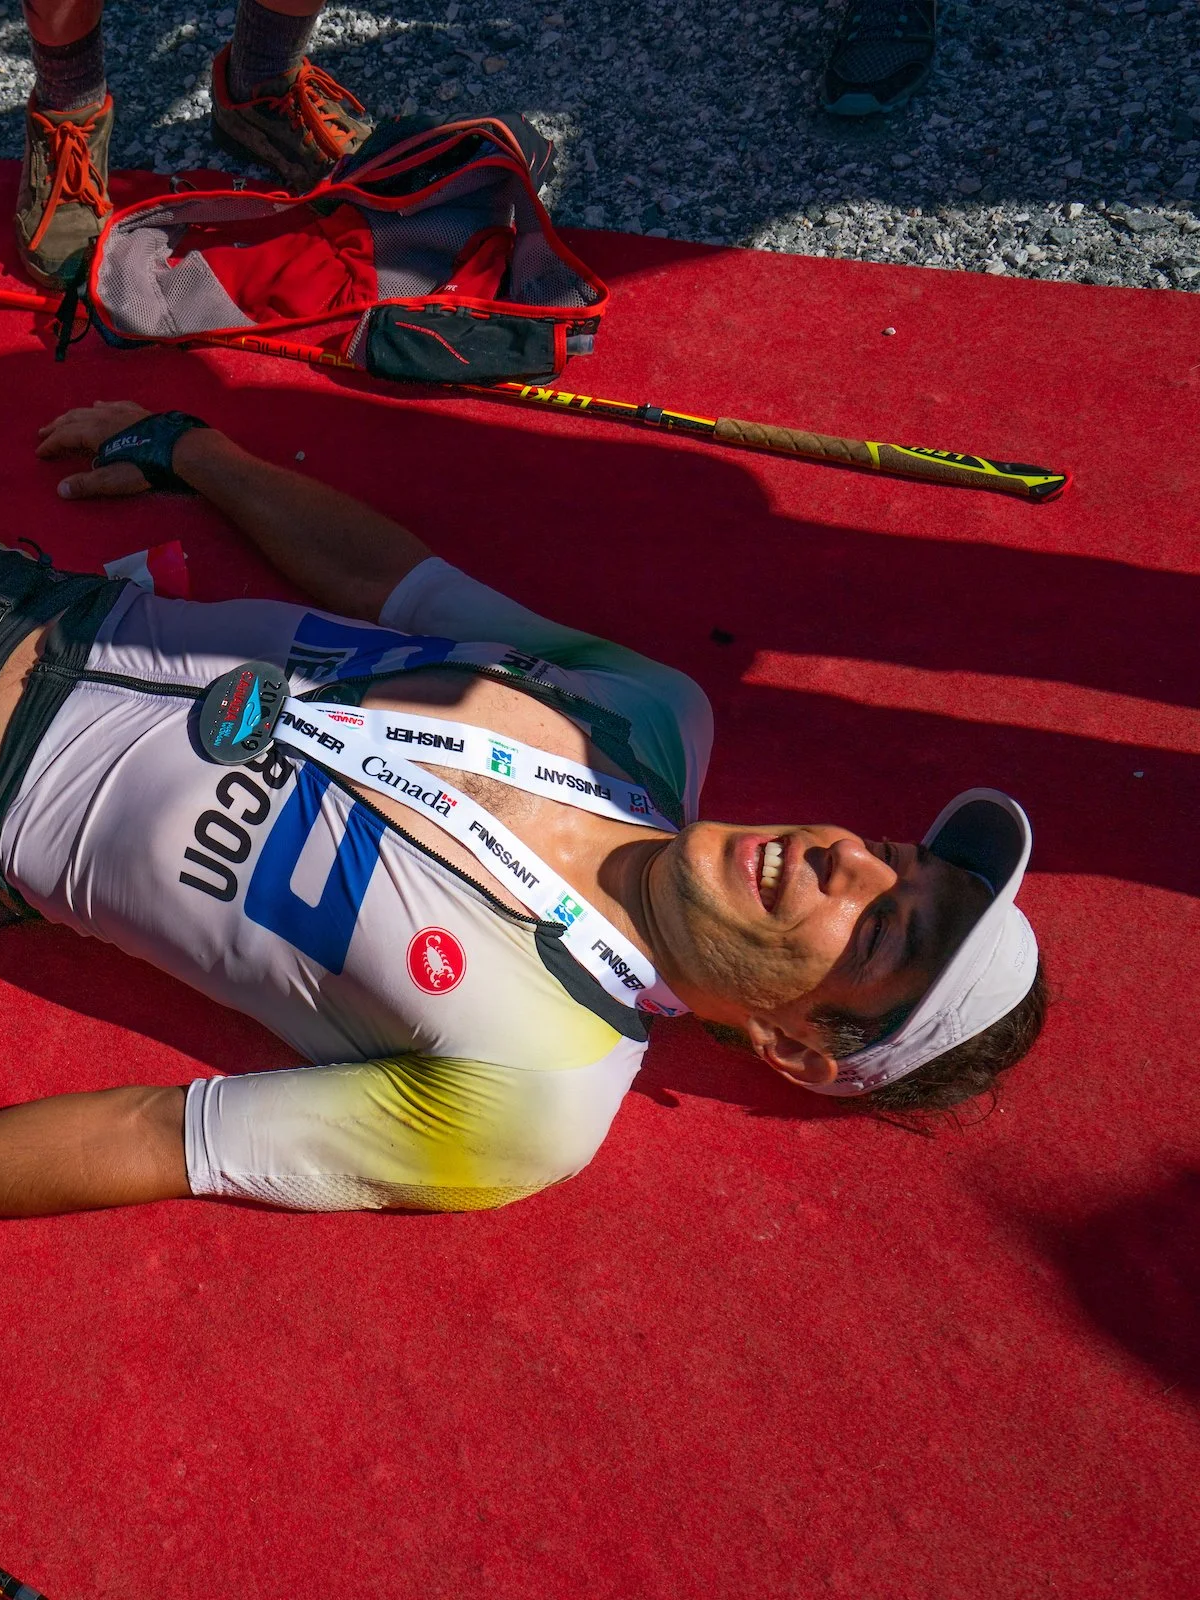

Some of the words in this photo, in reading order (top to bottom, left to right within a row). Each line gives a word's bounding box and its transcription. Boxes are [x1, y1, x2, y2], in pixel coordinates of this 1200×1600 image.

[519, 385, 593, 409] LEKI
[105, 435, 139, 452] LEKI
[223, 671, 254, 721] CANADA
[280, 711, 346, 755] FINISHER
[386, 726, 465, 753] FINISHER
[361, 756, 452, 818] Canada
[535, 765, 611, 801] FINISSANT
[468, 820, 540, 890] FINISSANT
[591, 939, 646, 992] FINISHER
